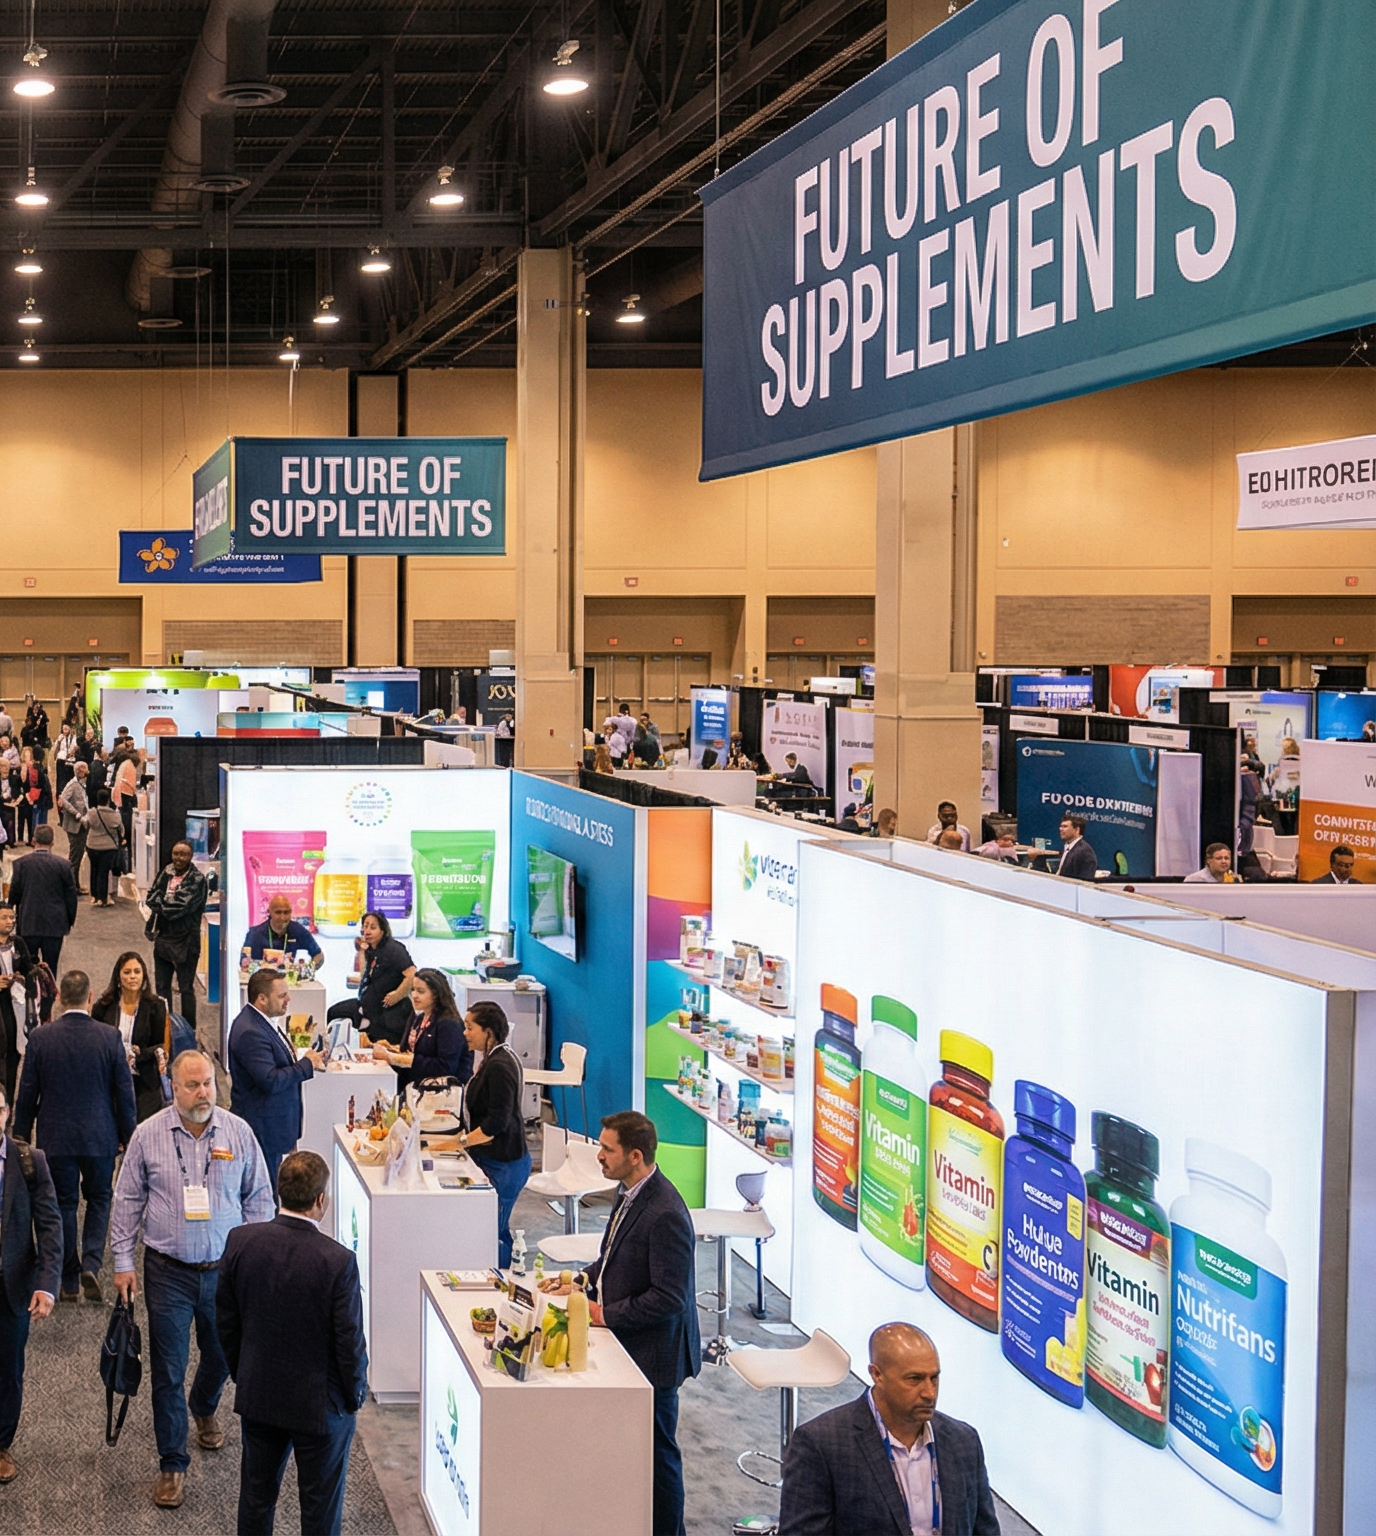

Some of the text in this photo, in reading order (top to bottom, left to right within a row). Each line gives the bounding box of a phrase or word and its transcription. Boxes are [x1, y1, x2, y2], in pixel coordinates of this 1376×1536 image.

[794, 0, 1124, 285] FUTURE OF
[760, 97, 1237, 417] SUPPLEMENTS
[281, 456, 462, 494] FUTURE OF
[249, 499, 492, 537] SUPPLEMENTS
[865, 1109, 921, 1167] Vitamin
[934, 1149, 995, 1210] Vitamin
[1086, 1246, 1160, 1316] Vitamin
